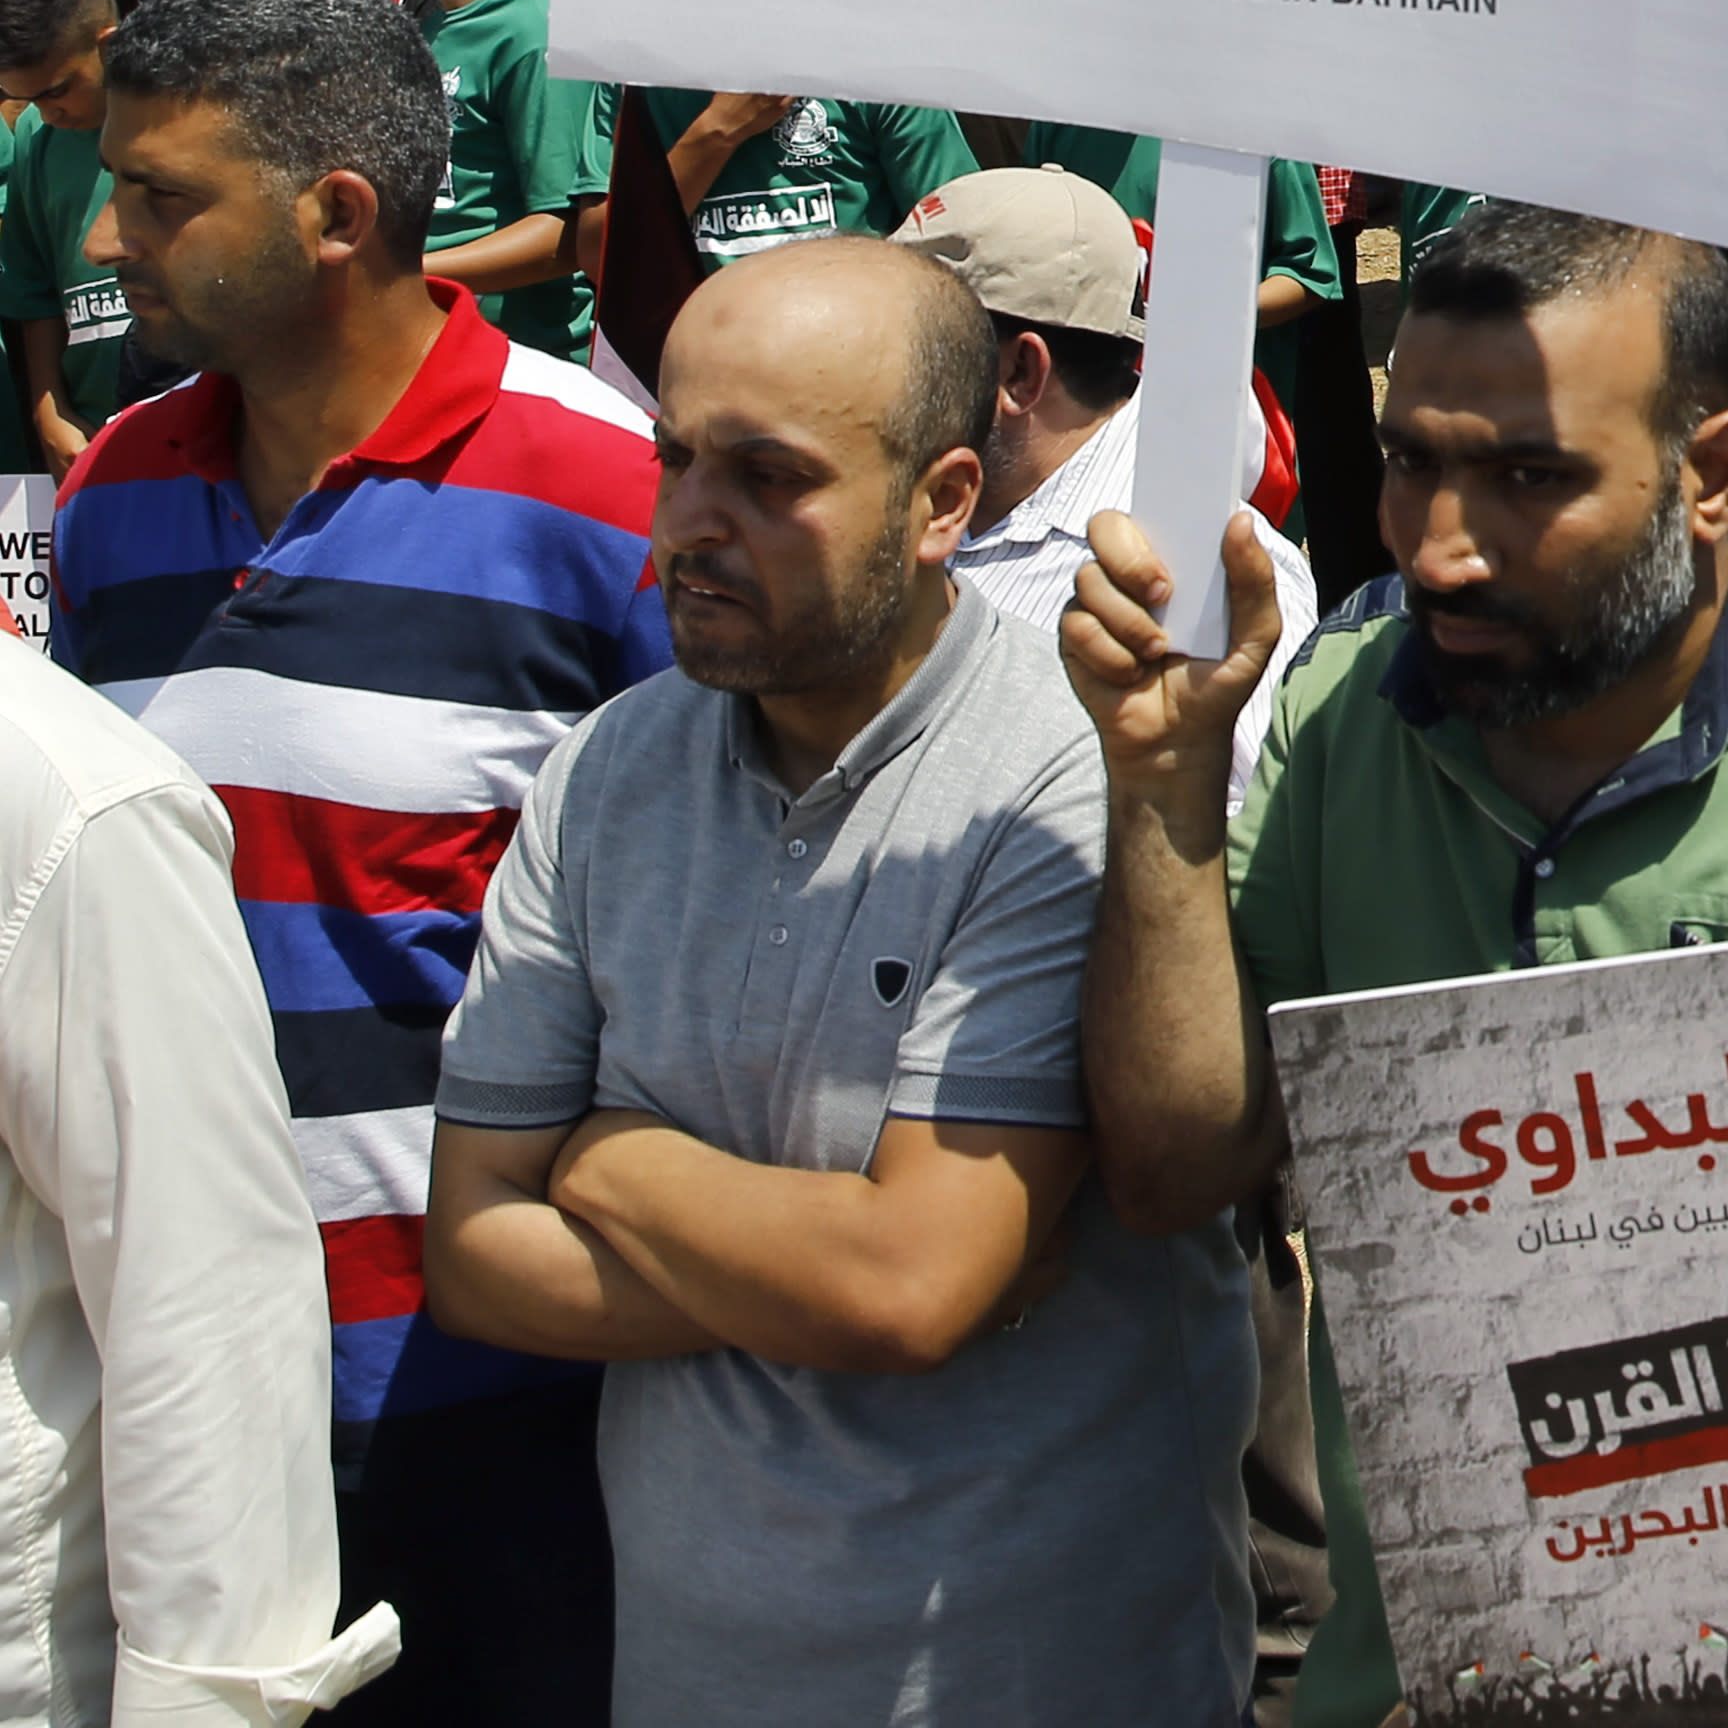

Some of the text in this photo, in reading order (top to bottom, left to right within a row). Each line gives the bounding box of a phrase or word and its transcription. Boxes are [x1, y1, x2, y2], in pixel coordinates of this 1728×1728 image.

[726, 197, 809, 233] لصفقة
[1517, 1214, 1598, 1255] لبنان
[1608, 1204, 1666, 1250] في
[1529, 1345, 1724, 1459] القرن
